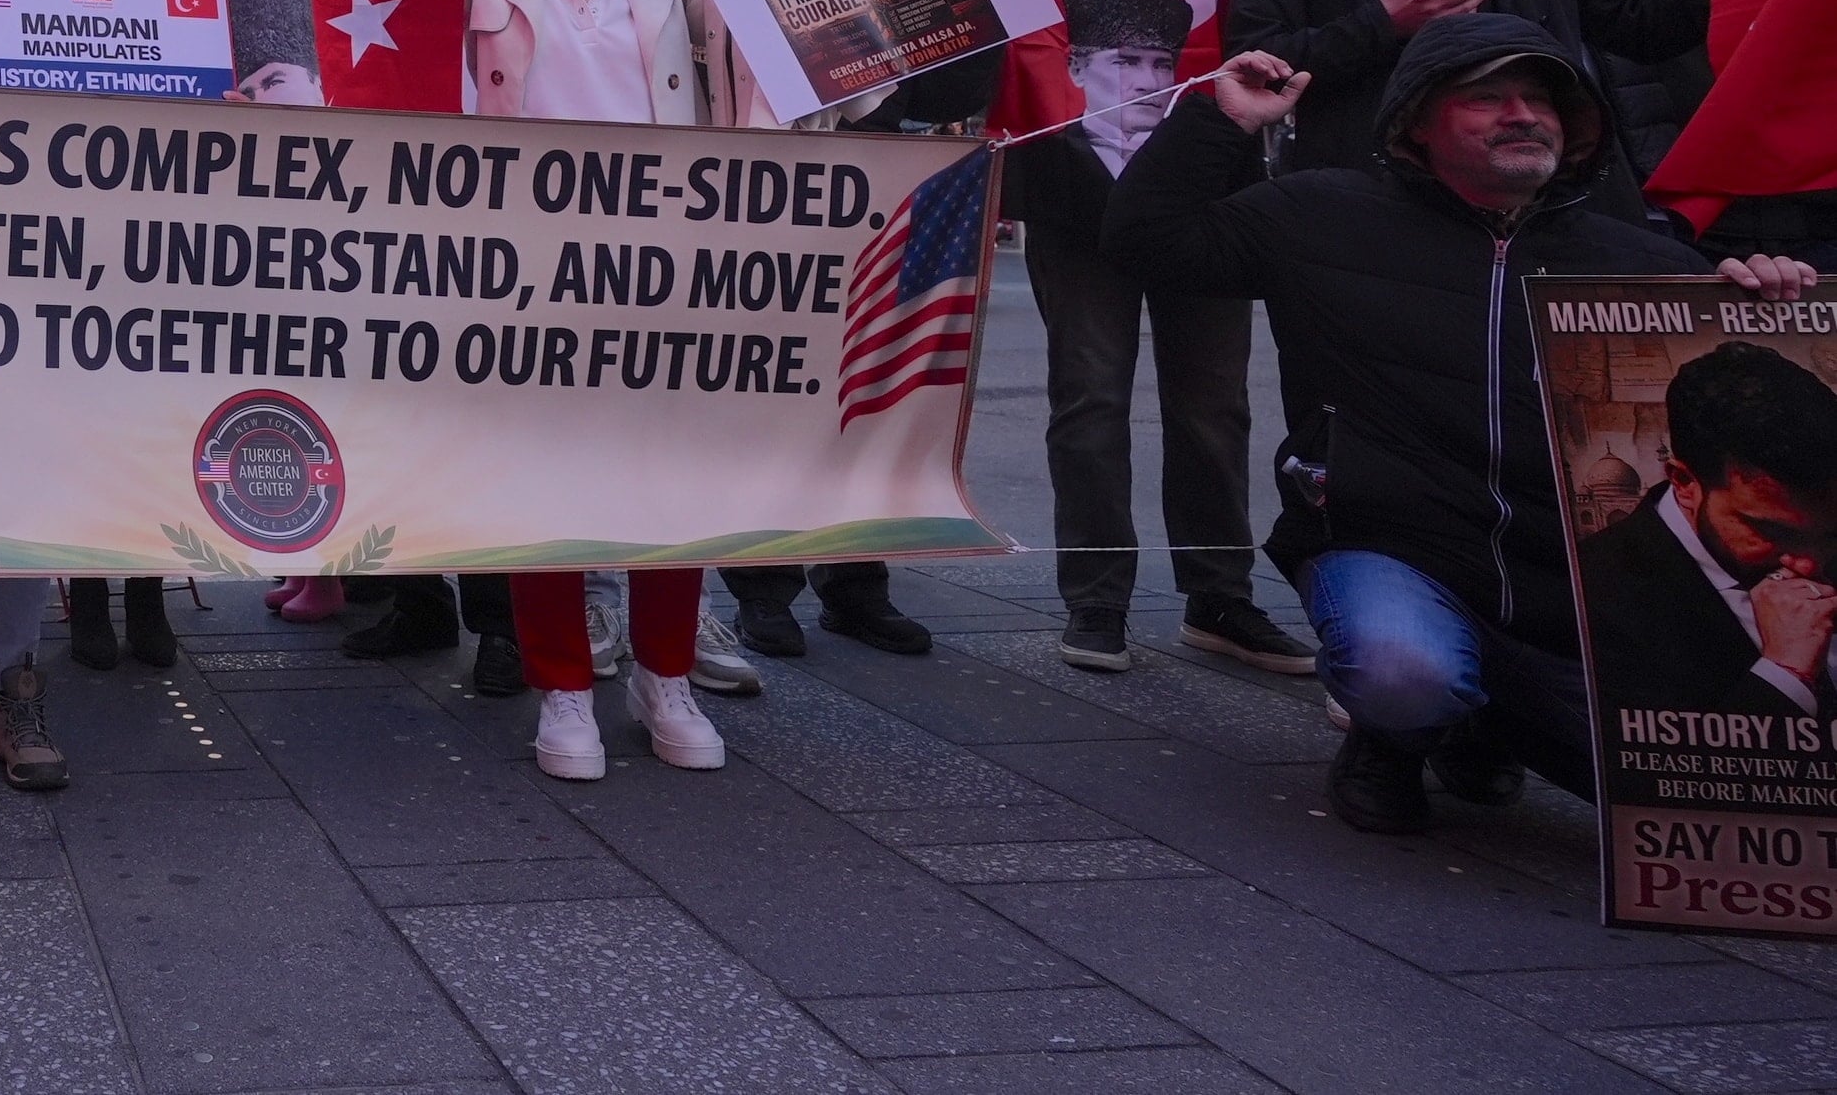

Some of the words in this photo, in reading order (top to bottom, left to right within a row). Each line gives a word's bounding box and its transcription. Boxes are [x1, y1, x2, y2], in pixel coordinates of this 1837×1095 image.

[20, 12, 159, 40] MAMDANI
[23, 39, 162, 61] MANIPULATES
[866, 41, 917, 68] AZINLIKTA
[918, 28, 954, 48] KALSA
[957, 20, 977, 35] DA,
[86, 72, 203, 96] ETHNICITY,
[47, 122, 369, 214] COMPLEX,
[388, 140, 520, 211] NOT
[532, 148, 885, 231] ONE-SIDED.
[123, 219, 536, 311] UNDERSTAND,
[549, 242, 675, 308] AND
[687, 249, 844, 315] MOVE
[1547, 301, 1695, 333] MAMDANI
[35, 303, 347, 379] TOGETHER
[364, 319, 440, 383] TO
[455, 323, 579, 388] OUR
[586, 328, 821, 395] FUTURE.
[235, 417, 259, 435] NEW
[268, 417, 298, 437] YORK
[241, 447, 292, 463] TURKISH
[239, 465, 300, 480] AMERICAN
[248, 481, 294, 497] CENTER
[239, 507, 276, 530] SINCE
[285, 507, 312, 528] 2018
[1619, 708, 1773, 750] HISTORY
[1784, 716, 1820, 752] IS
[1619, 750, 1704, 773] PLEASE
[1710, 755, 1798, 778] REVIEW
[1805, 761, 1837, 781] AL
[1658, 779, 1744, 802] BEFORE
[1634, 819, 1722, 862] SAY
[1738, 825, 1802, 867] NO
[1633, 861, 1837, 921] Press
